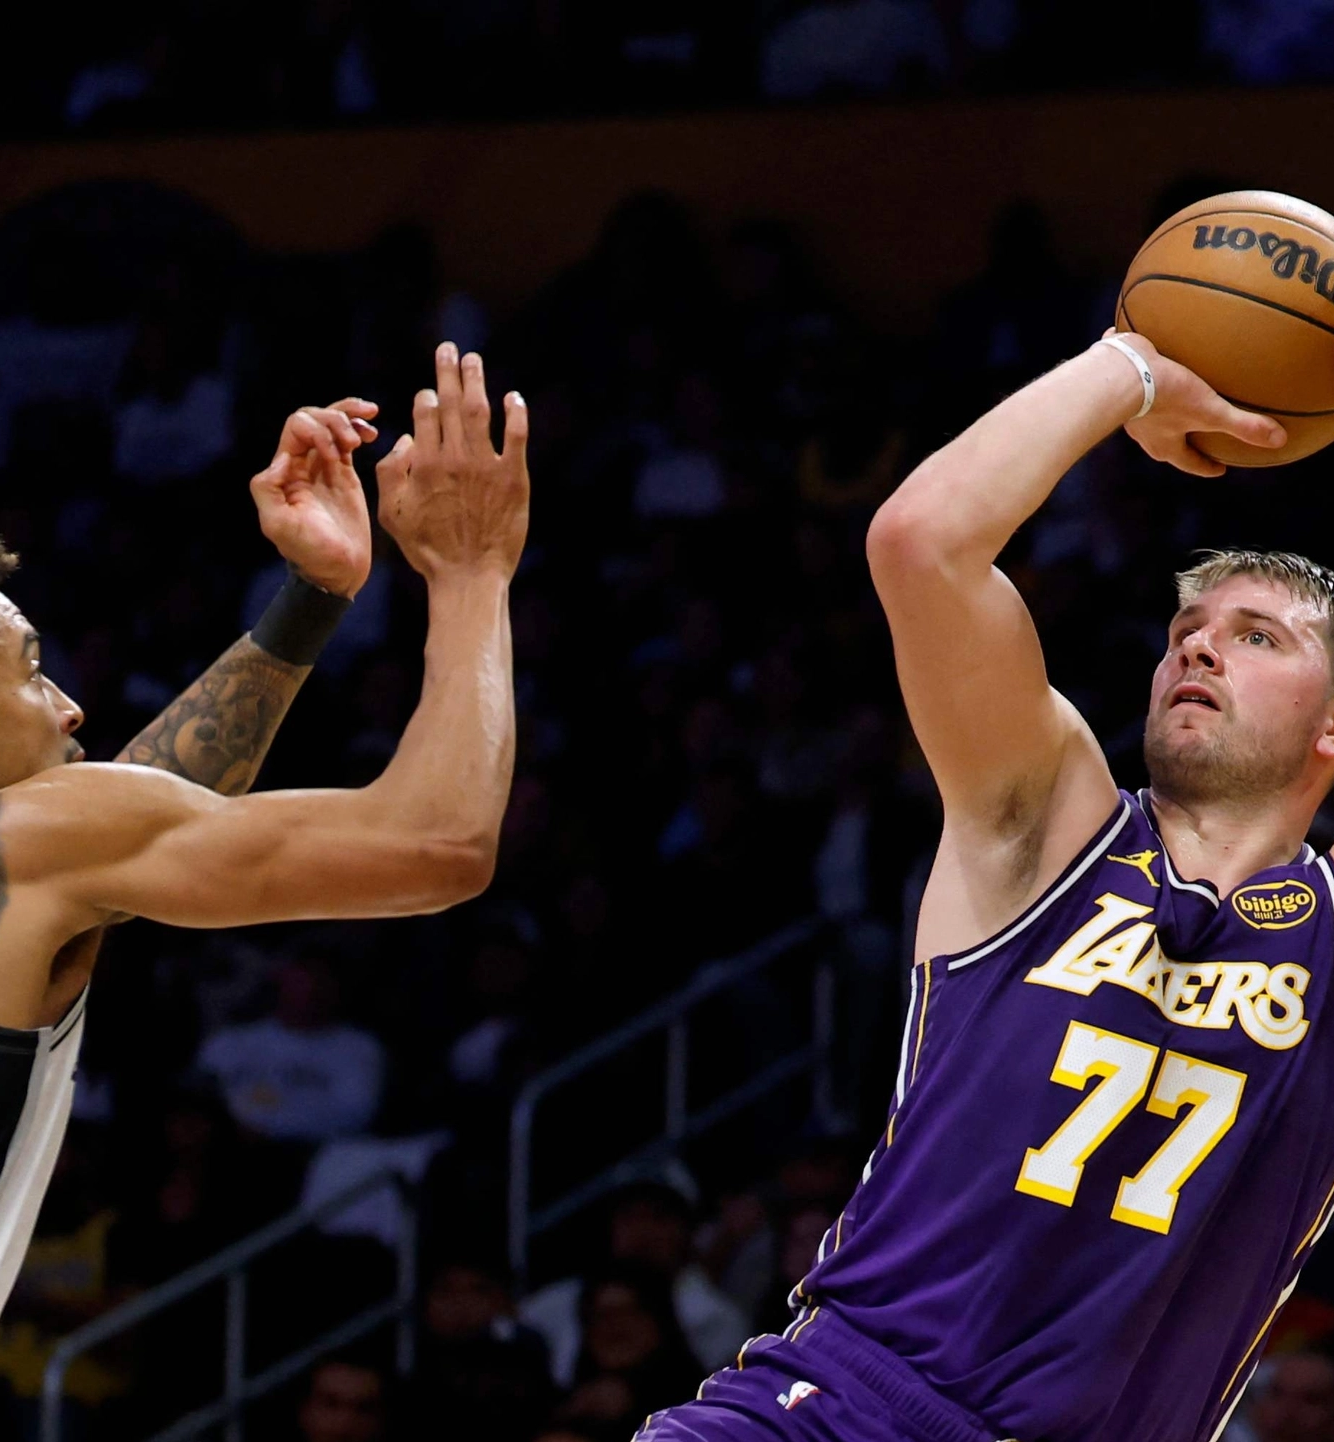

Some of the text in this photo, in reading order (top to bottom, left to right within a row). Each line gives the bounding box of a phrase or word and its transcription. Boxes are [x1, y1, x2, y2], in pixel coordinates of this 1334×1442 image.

[1023, 892, 1312, 1051] LAKERS
[1238, 892, 1311, 914] bibigo
[1014, 1020, 1248, 1235] 77
